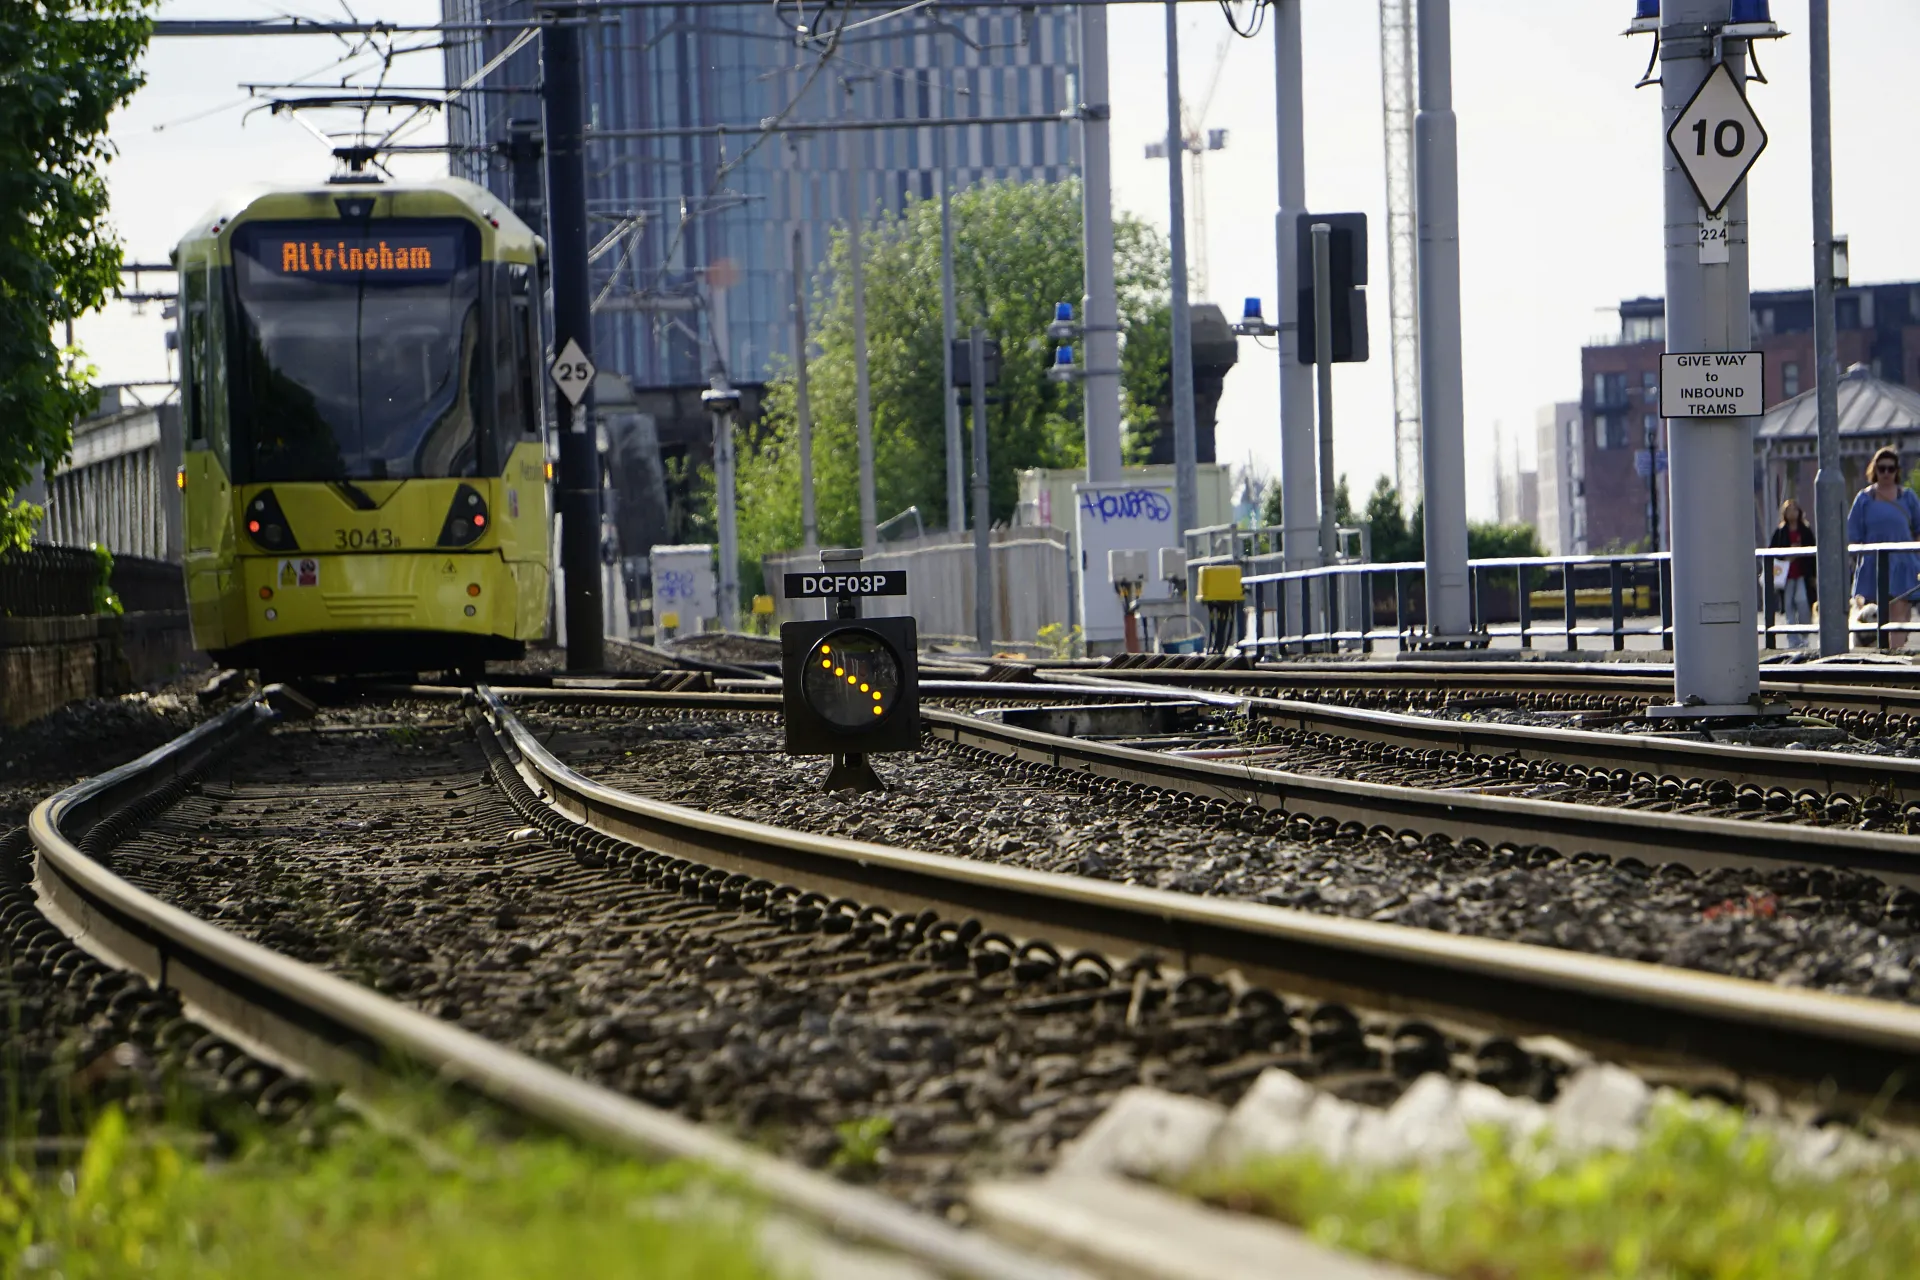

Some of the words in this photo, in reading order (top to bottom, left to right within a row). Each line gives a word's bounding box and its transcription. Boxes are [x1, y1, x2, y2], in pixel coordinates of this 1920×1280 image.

[1692, 119, 1745, 157] 10
[1700, 228, 1727, 241] 224
[282, 240, 431, 272] Altrincham
[1677, 355, 1711, 367] GIVE
[1715, 354, 1747, 366] WAY
[559, 362, 588, 382] 25
[1705, 371, 1719, 382] to
[1680, 387, 1744, 399] INBOUND
[1687, 403, 1737, 415] TRAMS
[802, 575, 887, 594] DCF03P
